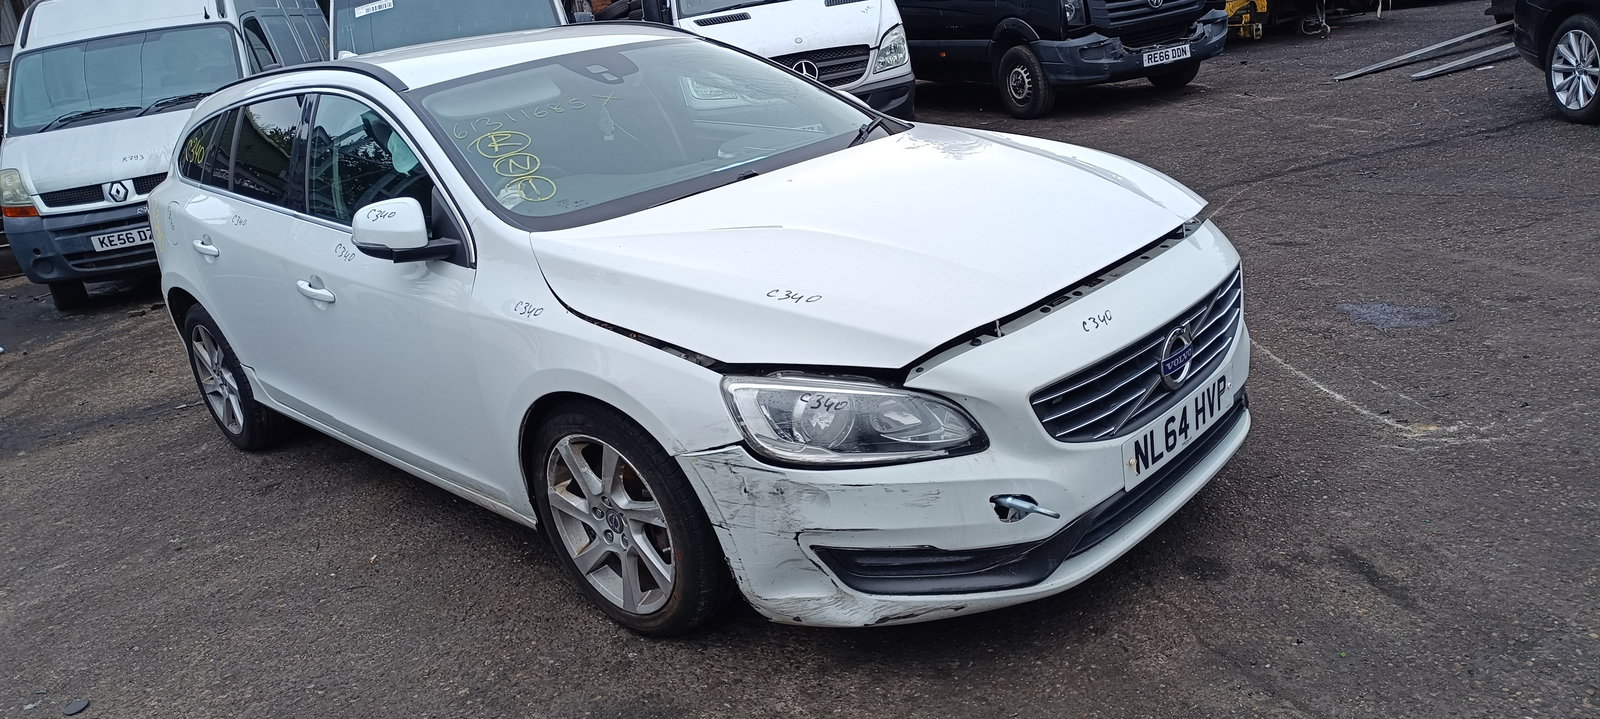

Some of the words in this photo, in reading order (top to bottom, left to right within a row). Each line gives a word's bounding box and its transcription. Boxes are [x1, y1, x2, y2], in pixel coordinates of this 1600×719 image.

[1147, 51, 1169, 64] RE66
[122, 154, 145, 163] R793
[185, 137, 205, 164] C340
[231, 214, 248, 226] C340
[367, 208, 397, 222] C340
[97, 232, 135, 248] KE56
[334, 243, 356, 262] C340
[766, 289, 822, 304] C340
[513, 300, 544, 318] C340
[1082, 309, 1113, 332] C340
[1166, 348, 1192, 371] VOLVO
[799, 392, 848, 412] C340
[1134, 405, 1190, 475] NL64
[1194, 374, 1226, 431] HVP
